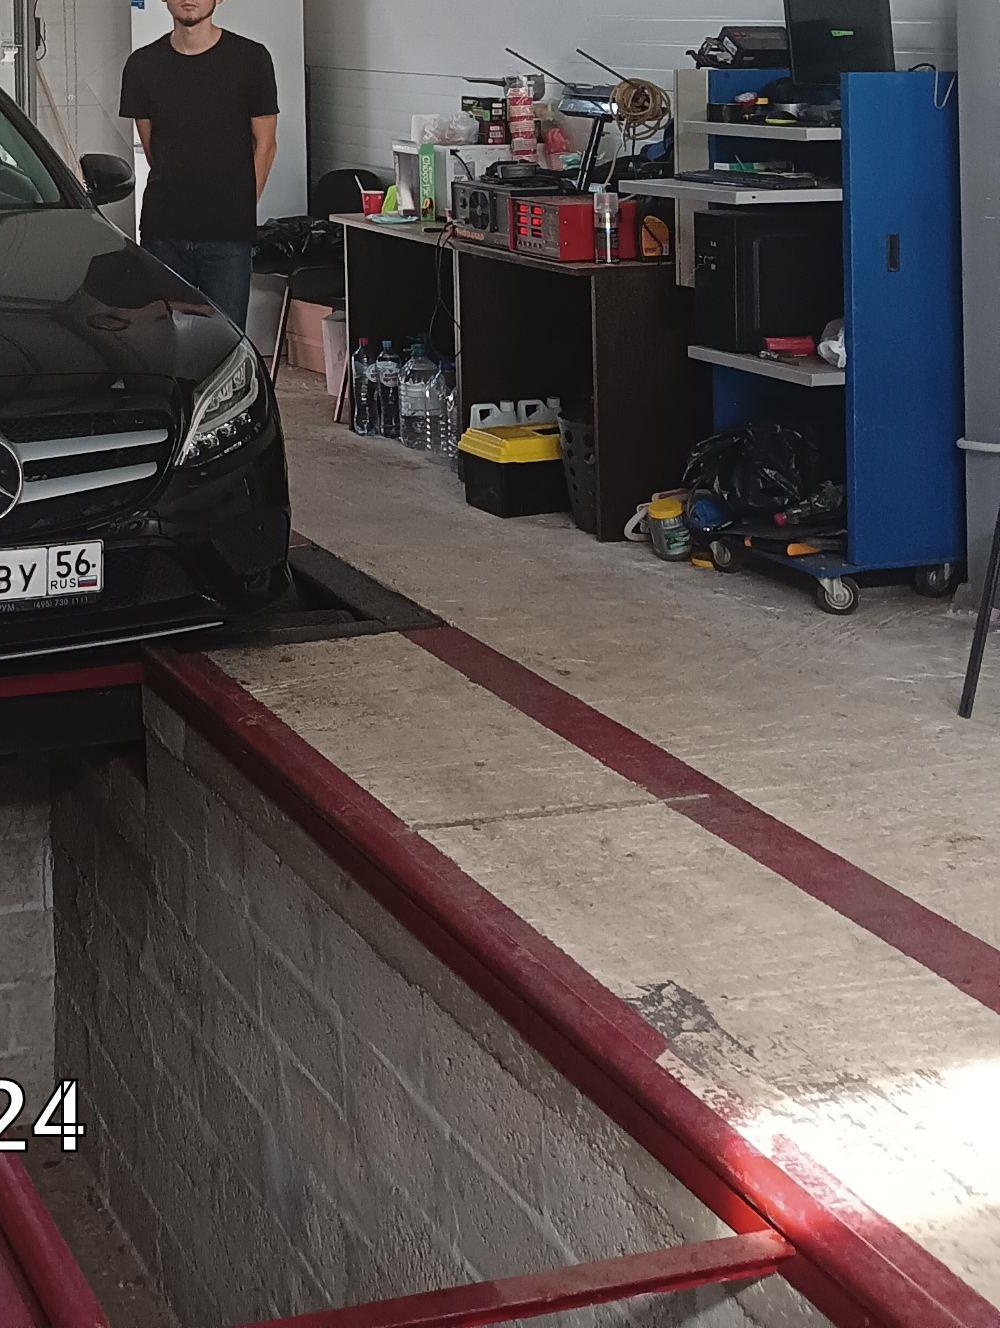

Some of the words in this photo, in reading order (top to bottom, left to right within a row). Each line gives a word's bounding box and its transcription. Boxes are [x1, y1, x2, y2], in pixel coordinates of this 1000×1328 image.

[56, 549, 91, 579] 56
[50, 577, 77, 591] RUS
[54, 598, 69, 608] 730
